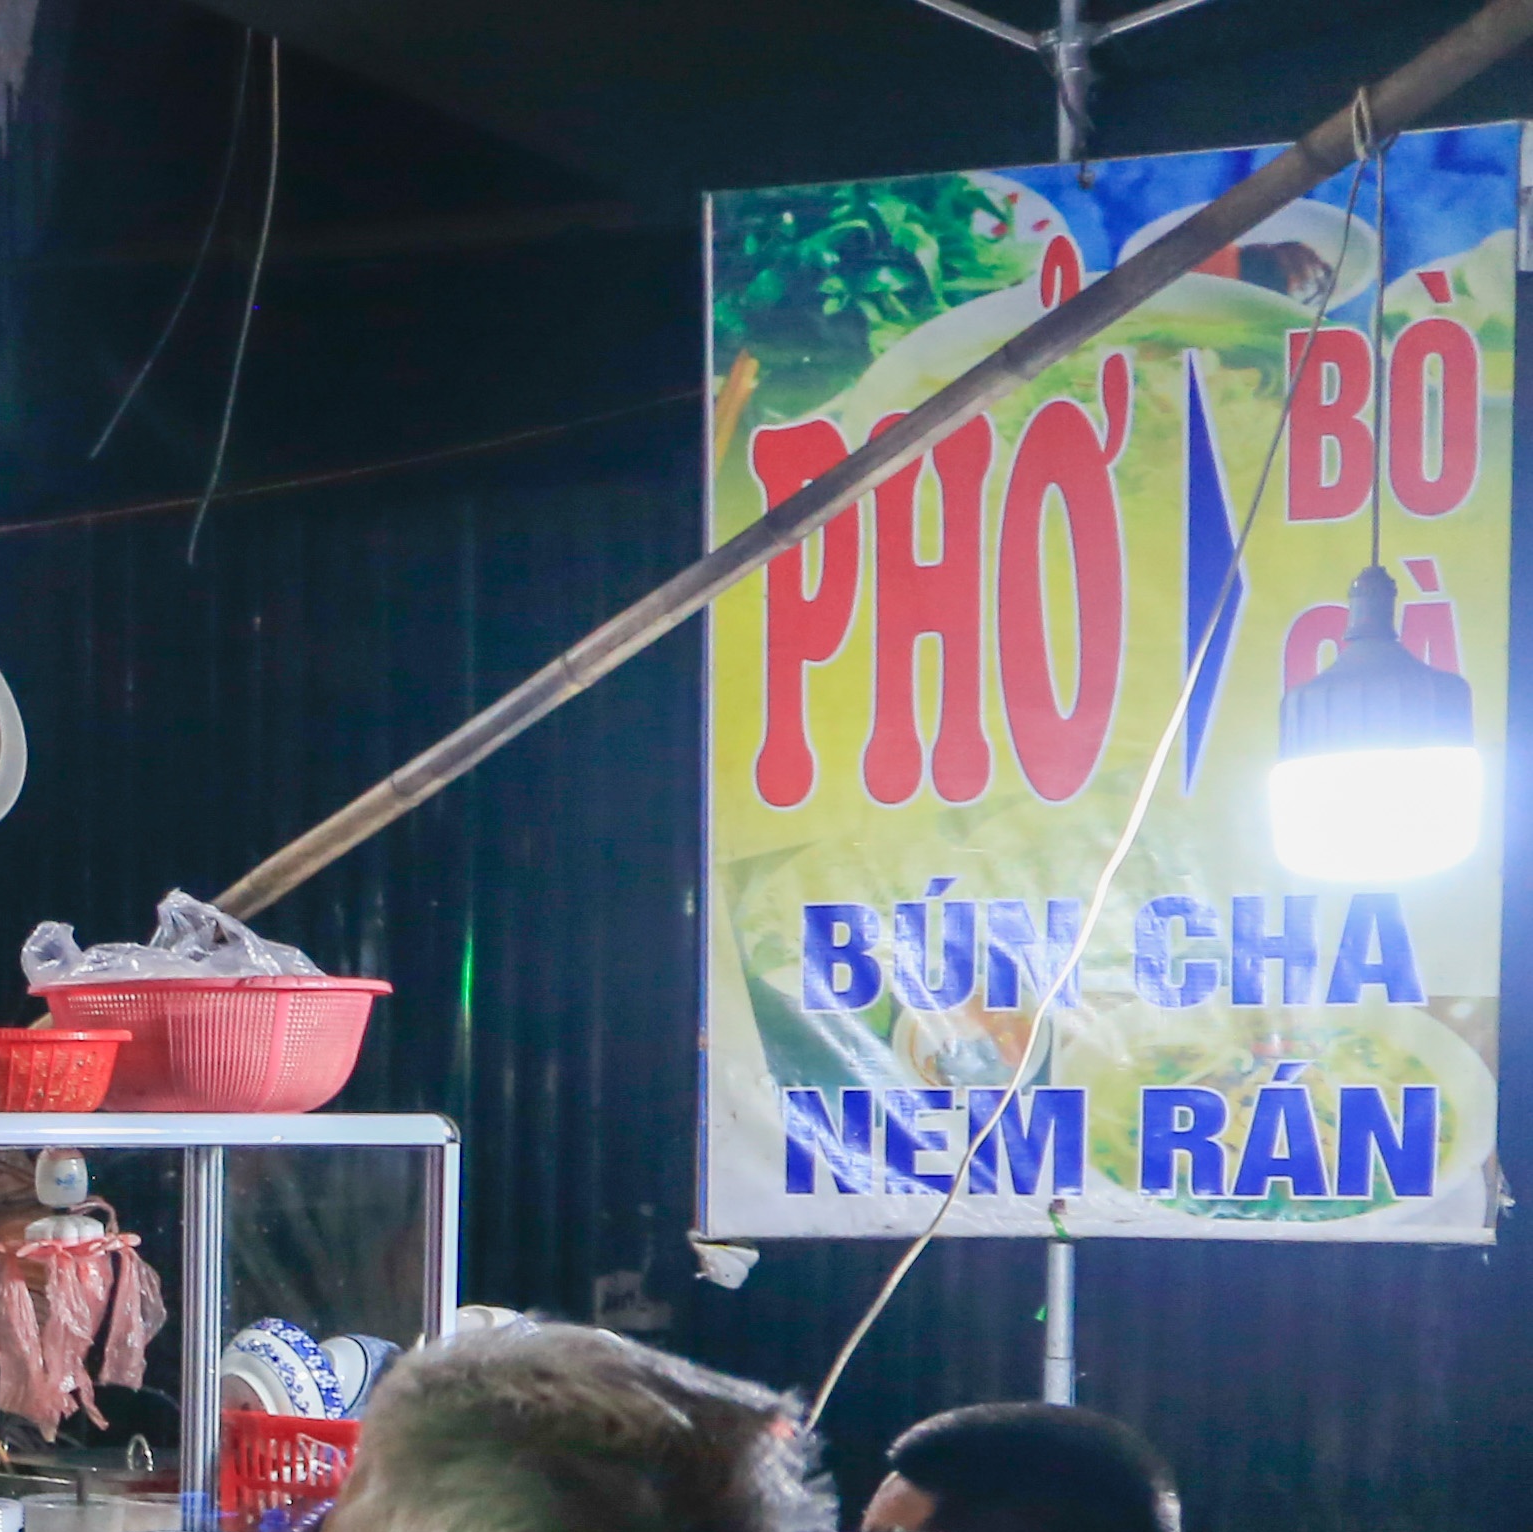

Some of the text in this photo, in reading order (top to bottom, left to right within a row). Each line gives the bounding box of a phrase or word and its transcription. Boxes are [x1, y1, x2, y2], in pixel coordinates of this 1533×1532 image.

[1285, 271, 1481, 524] BÒ
[749, 235, 1133, 808] PHỞ
[801, 876, 1082, 1014] BÚN
[783, 1060, 1440, 1199] NEM RÁN
